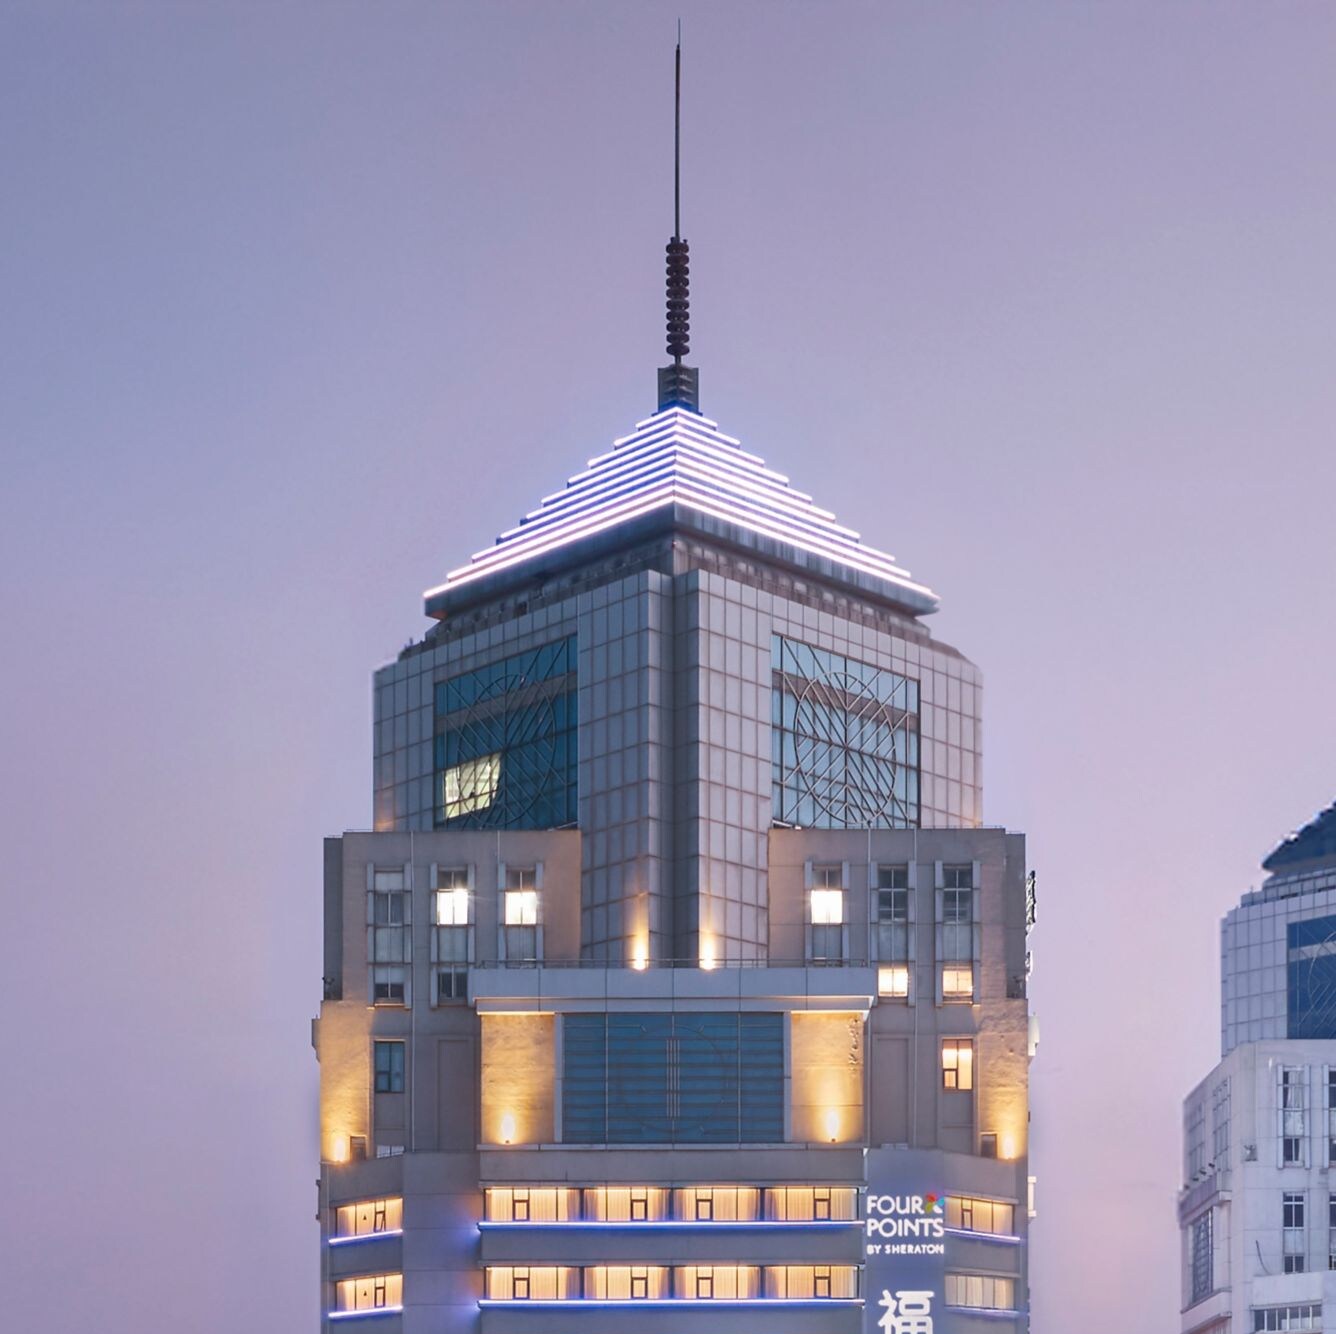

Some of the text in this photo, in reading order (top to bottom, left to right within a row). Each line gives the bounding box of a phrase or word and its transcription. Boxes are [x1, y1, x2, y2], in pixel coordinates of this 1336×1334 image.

[867, 1195, 924, 1215] FOUR
[867, 1218, 944, 1238] POINTS
[867, 1244, 944, 1255] BY SHERATON
